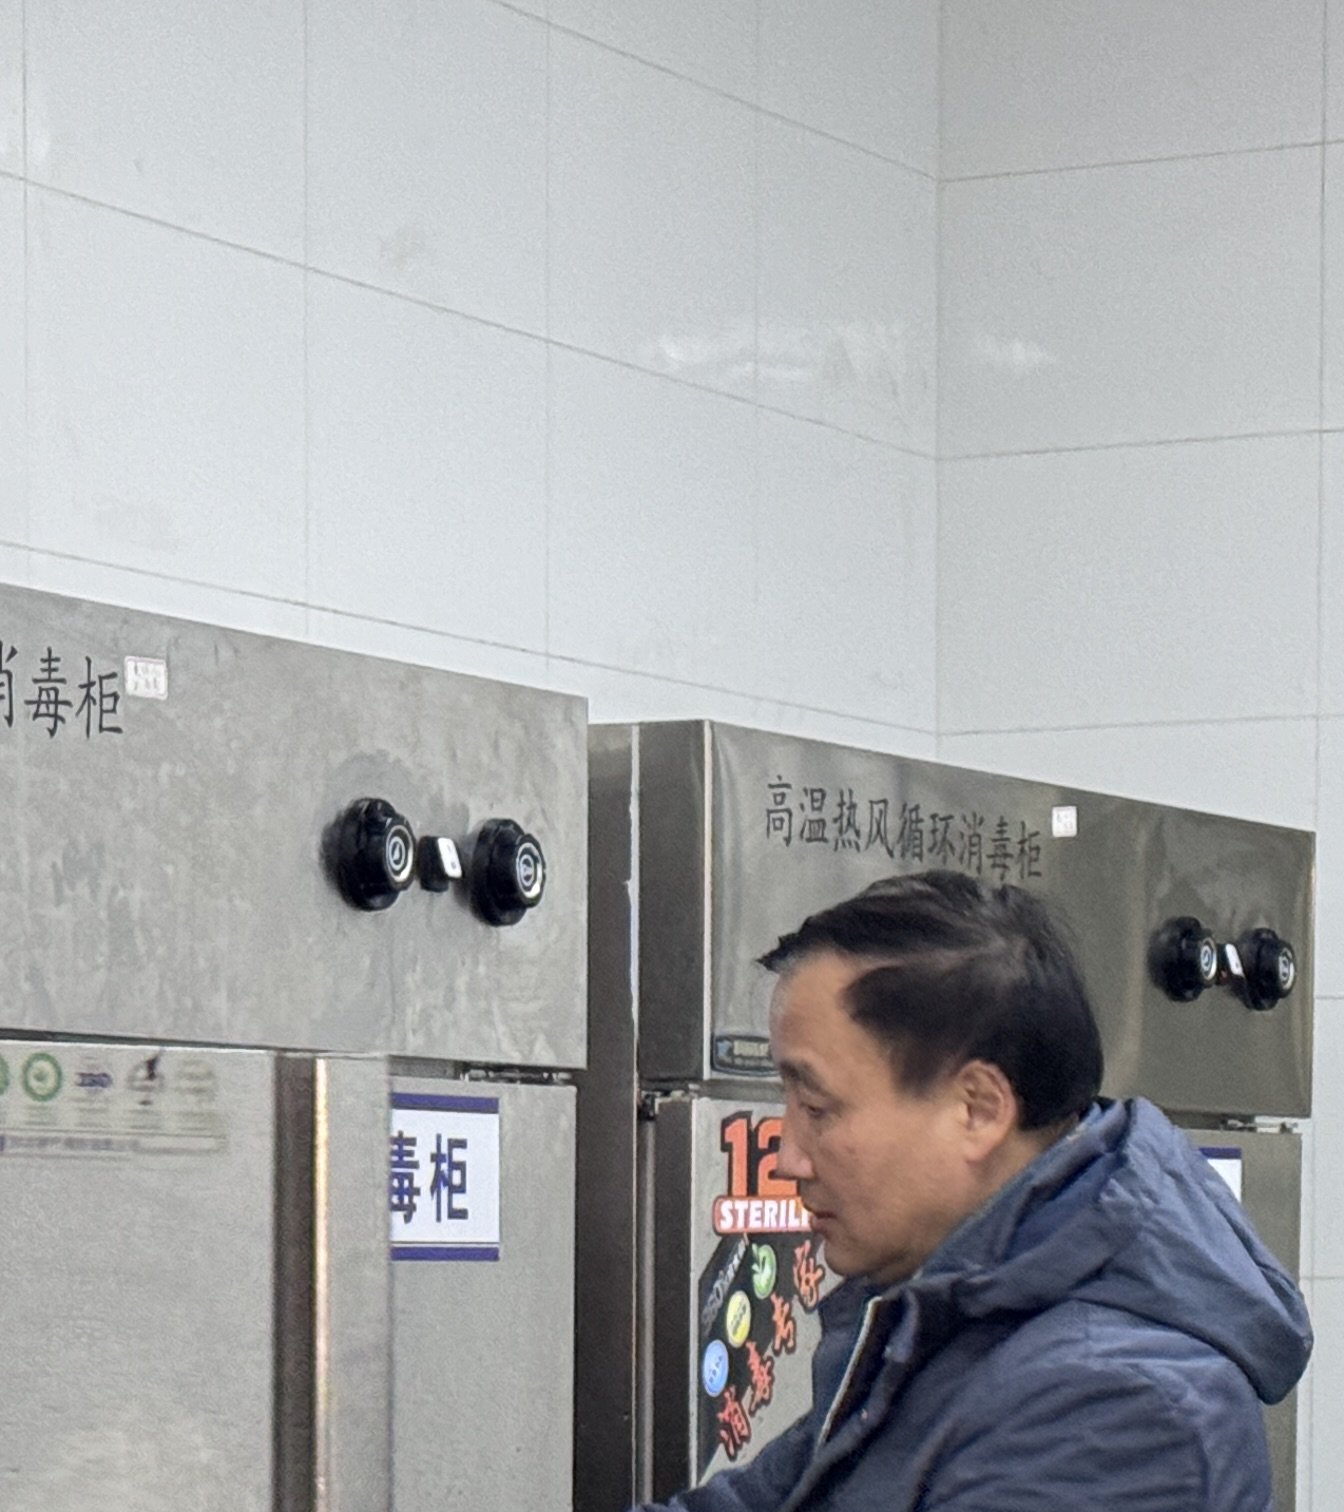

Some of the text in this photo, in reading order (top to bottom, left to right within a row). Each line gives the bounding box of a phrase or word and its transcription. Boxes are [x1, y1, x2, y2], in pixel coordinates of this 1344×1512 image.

[765, 774, 1043, 881] 高温热风循环消毒柜
